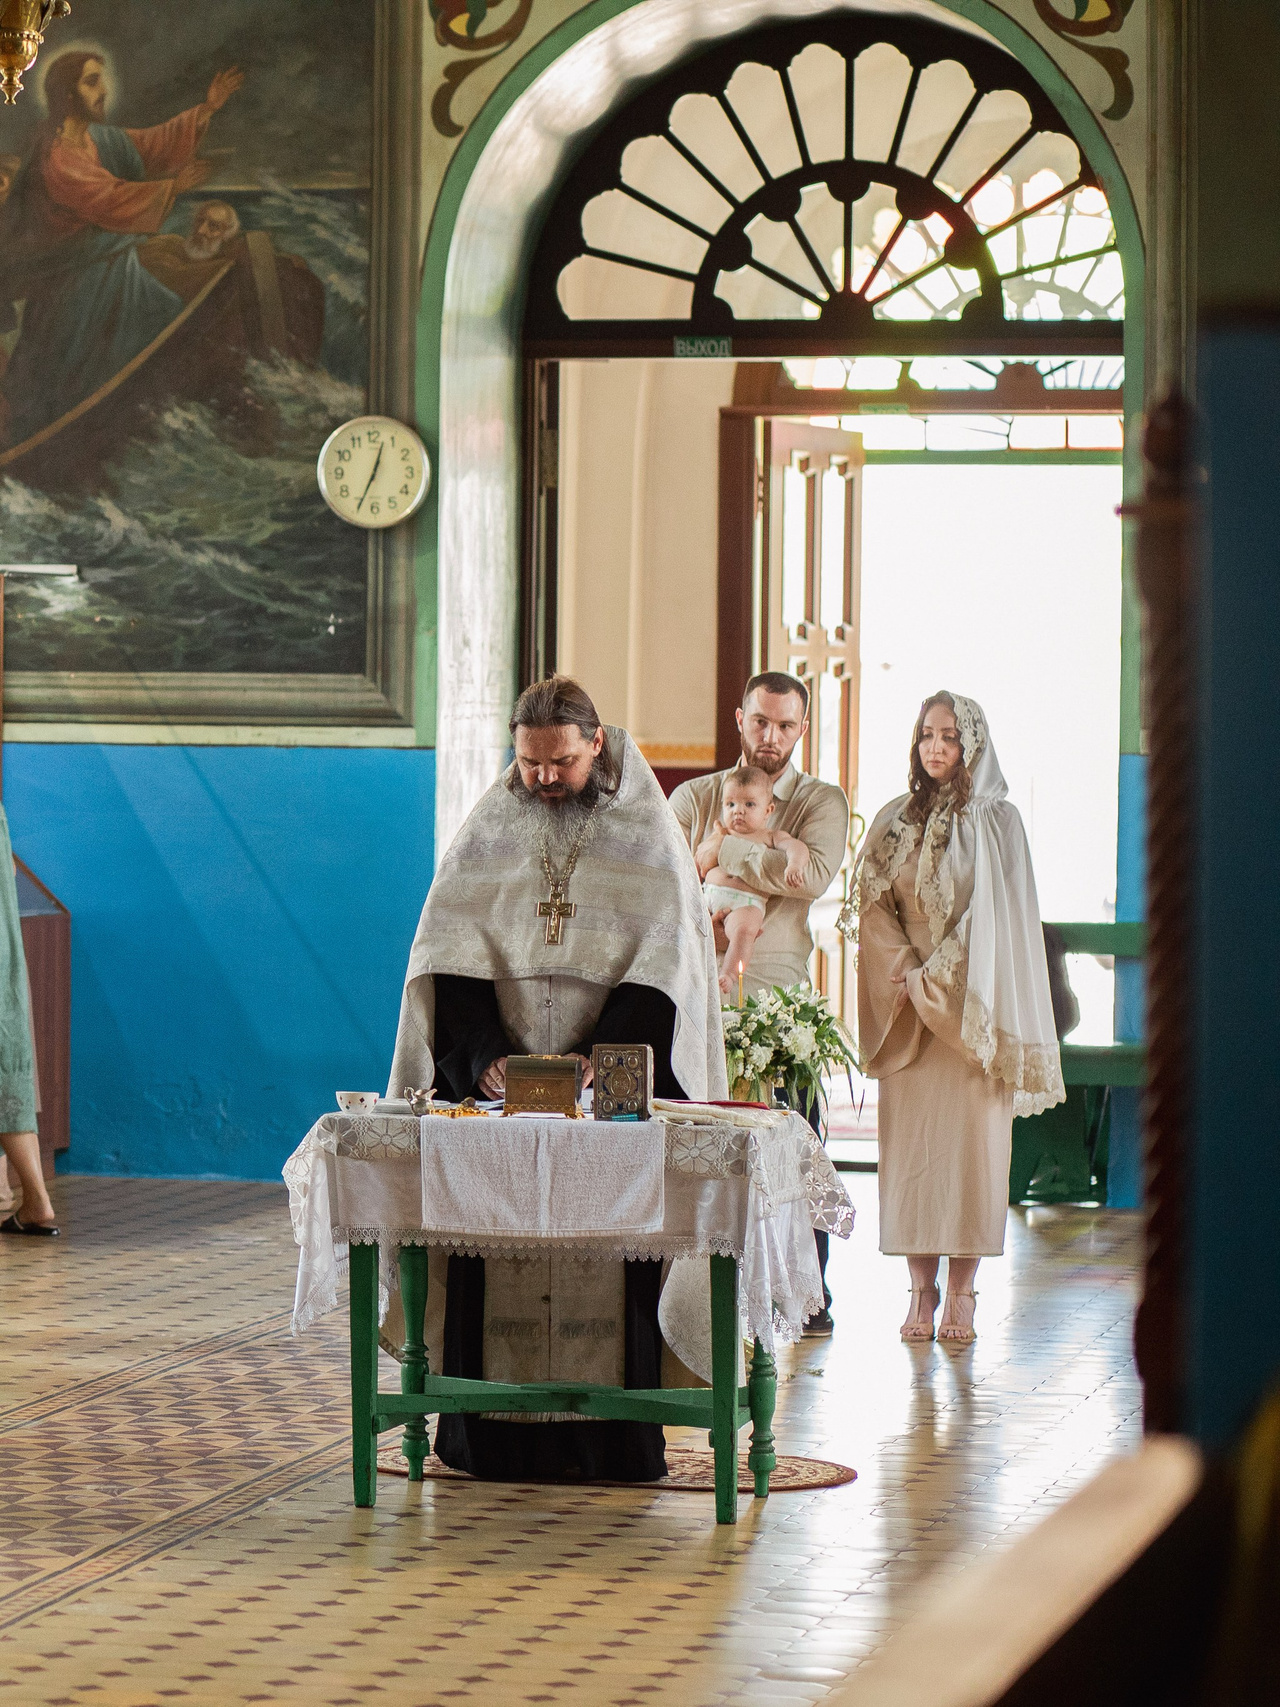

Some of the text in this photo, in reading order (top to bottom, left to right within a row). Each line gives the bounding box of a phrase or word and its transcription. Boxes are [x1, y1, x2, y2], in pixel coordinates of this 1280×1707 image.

[675, 339, 731, 356] ВЫХОД
[350, 436, 361, 448] 11
[367, 430, 380, 443] 12
[391, 436, 395, 448] 1
[336, 449, 351, 462] 10
[401, 448, 410, 461] 2
[334, 466, 344, 480] 9
[405, 466, 414, 479] 3
[340, 484, 349, 498] 8
[399, 484, 409, 495] 4
[370, 502, 379, 515] 6
[388, 496, 397, 509] 5
